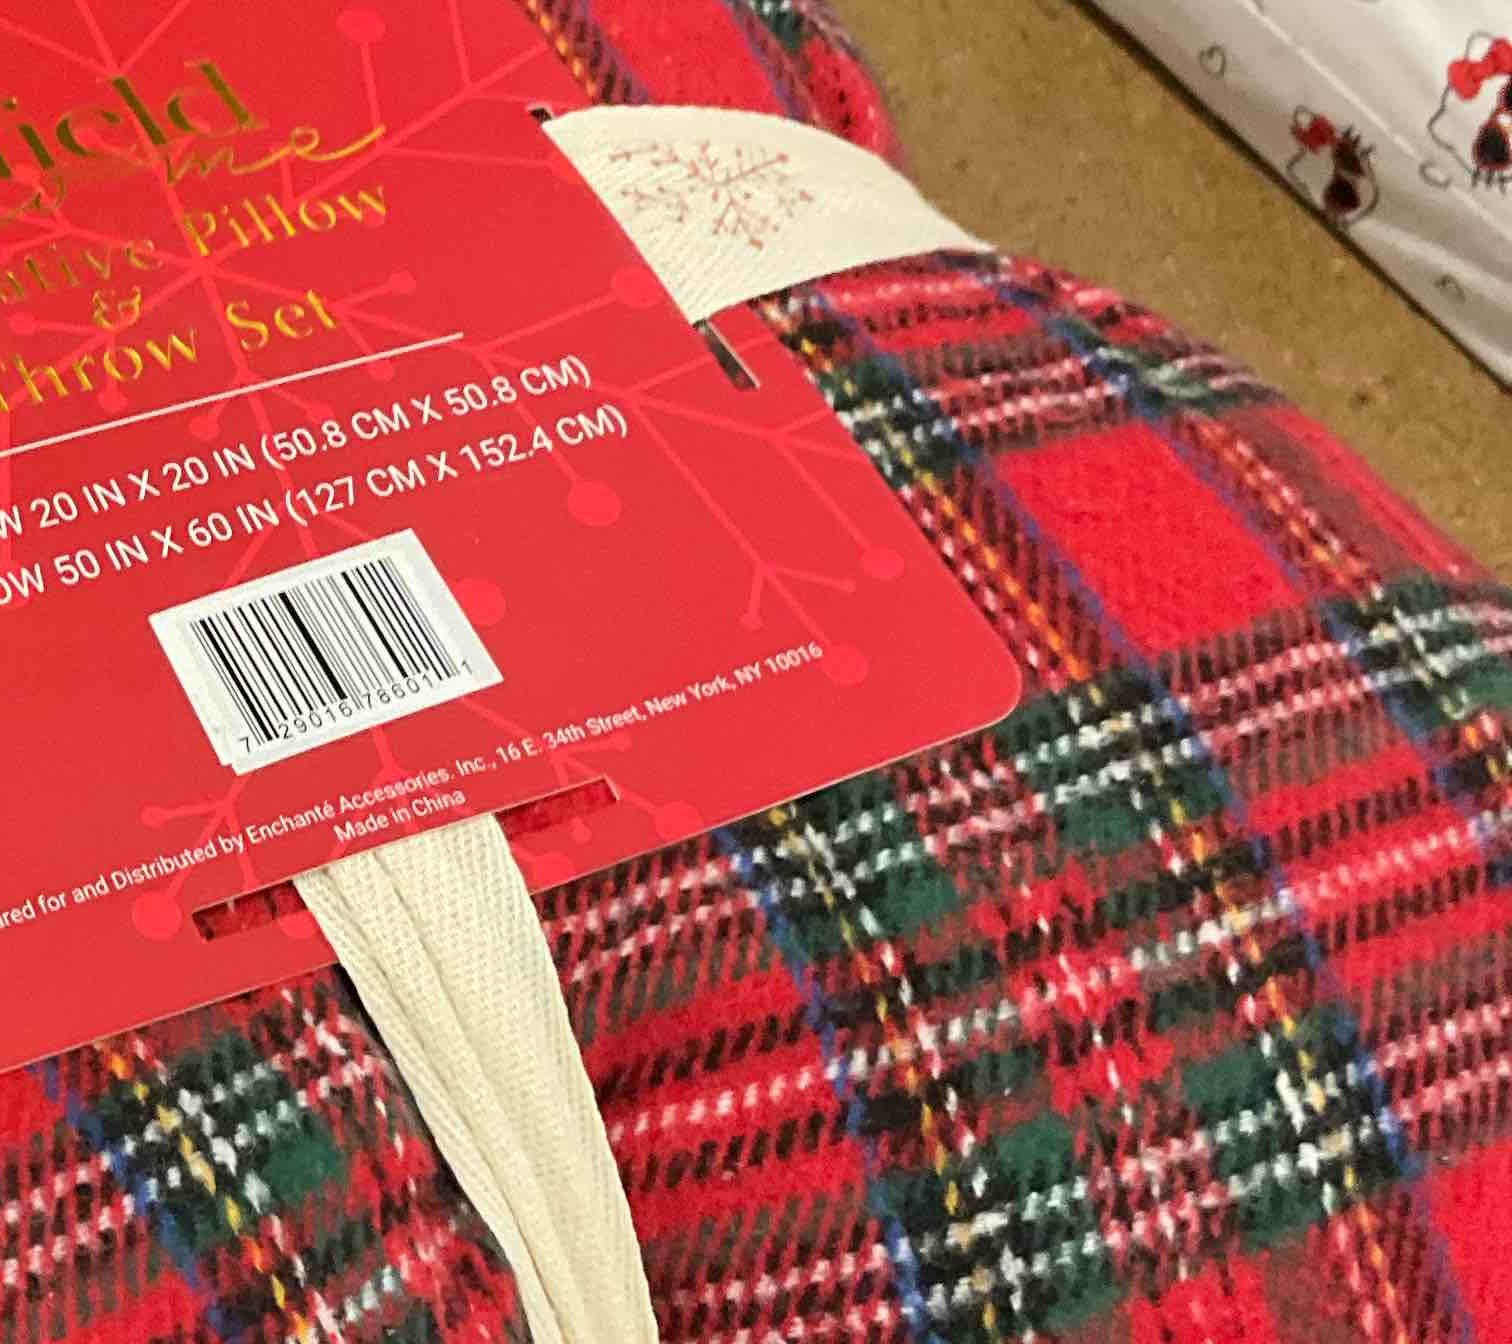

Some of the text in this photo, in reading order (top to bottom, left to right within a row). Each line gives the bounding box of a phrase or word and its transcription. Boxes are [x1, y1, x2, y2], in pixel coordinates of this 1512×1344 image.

[180, 184, 389, 258] Pillow
[91, 286, 143, 330] &
[225, 288, 338, 351] Set
[30, 491, 78, 529] 20
[82, 479, 126, 513] IN
[128, 468, 161, 501] X
[162, 456, 209, 492] 20
[212, 443, 256, 478] IN
[260, 420, 348, 471] (50.8
[351, 402, 411, 440] CM
[410, 394, 443, 425] X
[444, 375, 518, 416] 50.8
[519, 354, 591, 395] CM)
[53, 549, 101, 585] 50
[104, 535, 149, 571] IN
[150, 525, 185, 558] X
[187, 512, 233, 547] 60
[236, 499, 280, 534] IN
[285, 475, 358, 527] (127
[366, 459, 426, 497] CM
[426, 450, 459, 482] X
[460, 425, 553, 471] 152.4
[556, 404, 628, 445] CM)
[239, 659, 473, 754] 7 29016 78601 1
[38, 891, 67, 915] for
[71, 873, 110, 904] and
[110, 839, 218, 891] Distributed
[217, 833, 245, 858] by
[245, 799, 336, 845] Enchanté
[496, 742, 521, 764] 16
[521, 736, 543, 757] E.
[543, 723, 586, 750] 34th
[586, 704, 648, 737] Street,
[645, 691, 687, 717] New
[686, 674, 737, 702] York,
[735, 661, 762, 687] NY
[763, 641, 824, 674] 10016
[332, 790, 467, 843] Made in China
